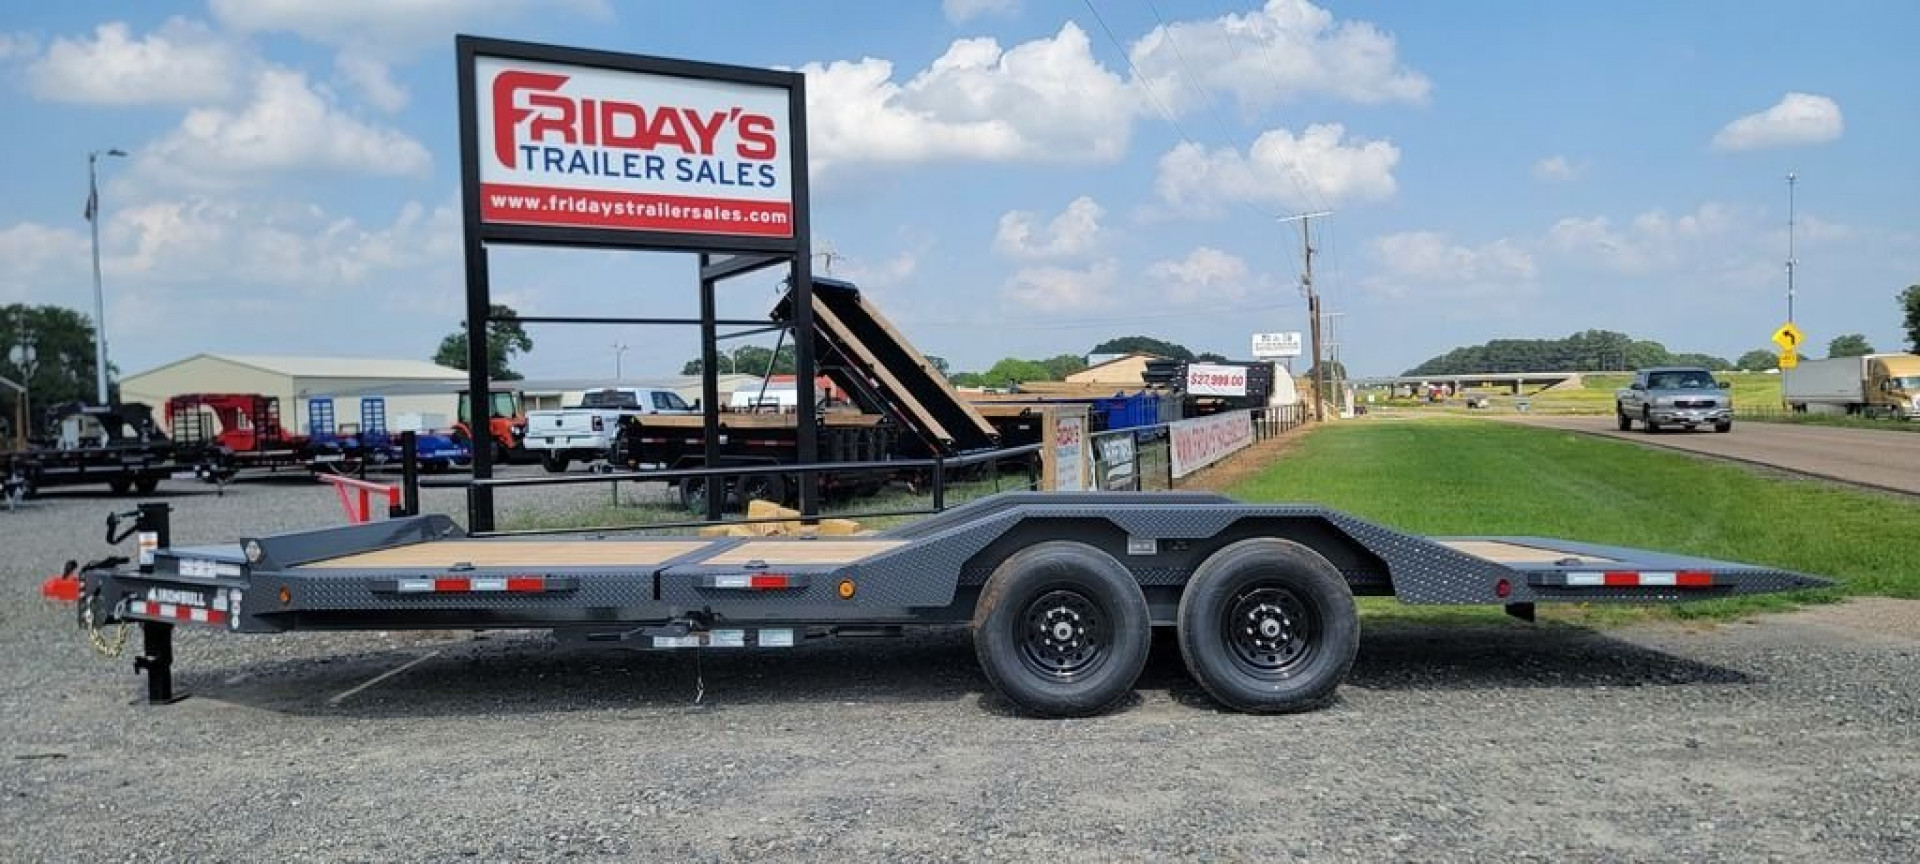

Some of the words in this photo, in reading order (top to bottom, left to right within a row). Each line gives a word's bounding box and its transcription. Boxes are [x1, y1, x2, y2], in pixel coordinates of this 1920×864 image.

[492, 70, 777, 169] FRIDAY'S
[520, 145, 665, 181] TRAILER
[675, 157, 776, 188] SALES
[490, 193, 788, 225] www.fridaystrailersales.com
